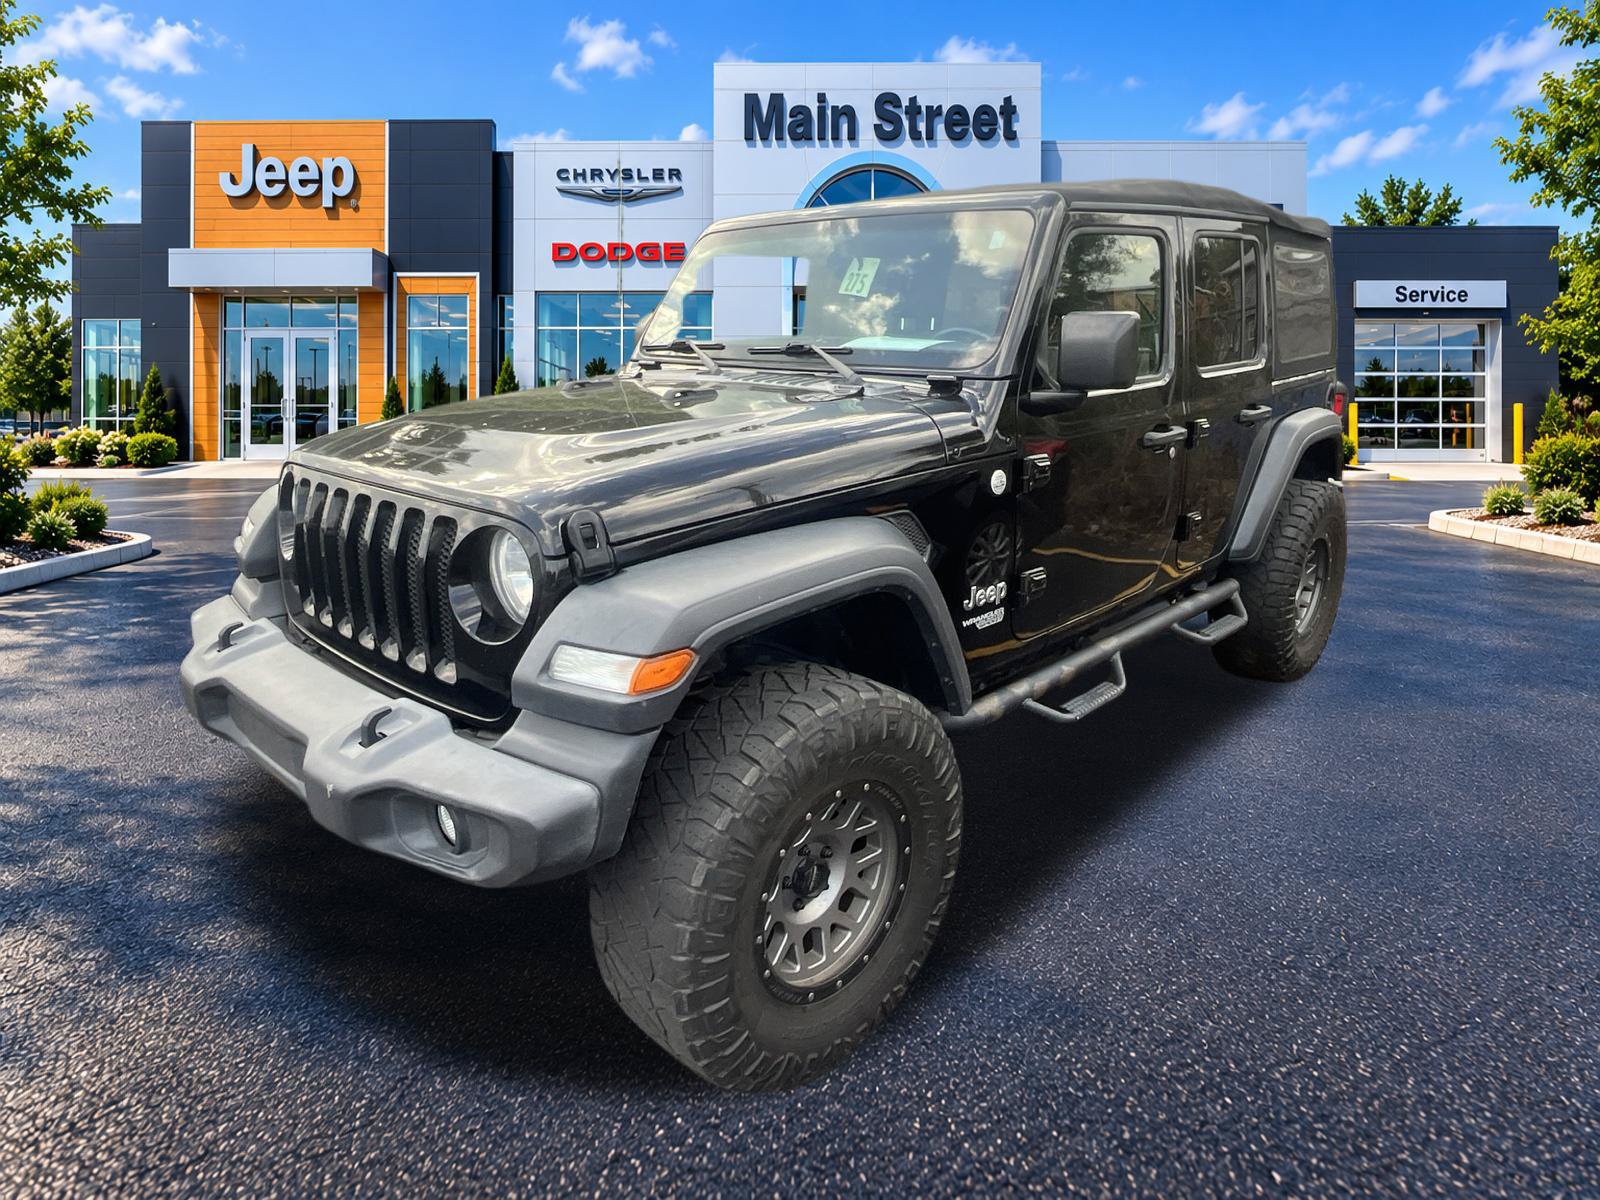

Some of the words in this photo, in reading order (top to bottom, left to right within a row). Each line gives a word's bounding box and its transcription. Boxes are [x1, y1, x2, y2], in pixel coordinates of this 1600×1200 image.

[744, 93, 857, 141] Main
[873, 91, 1017, 141] Street
[218, 143, 354, 209] Jeep
[556, 168, 683, 182] CHRYSLER
[551, 242, 686, 262] DODGE
[1395, 285, 1469, 303] Service
[963, 581, 1007, 611] Jeep
